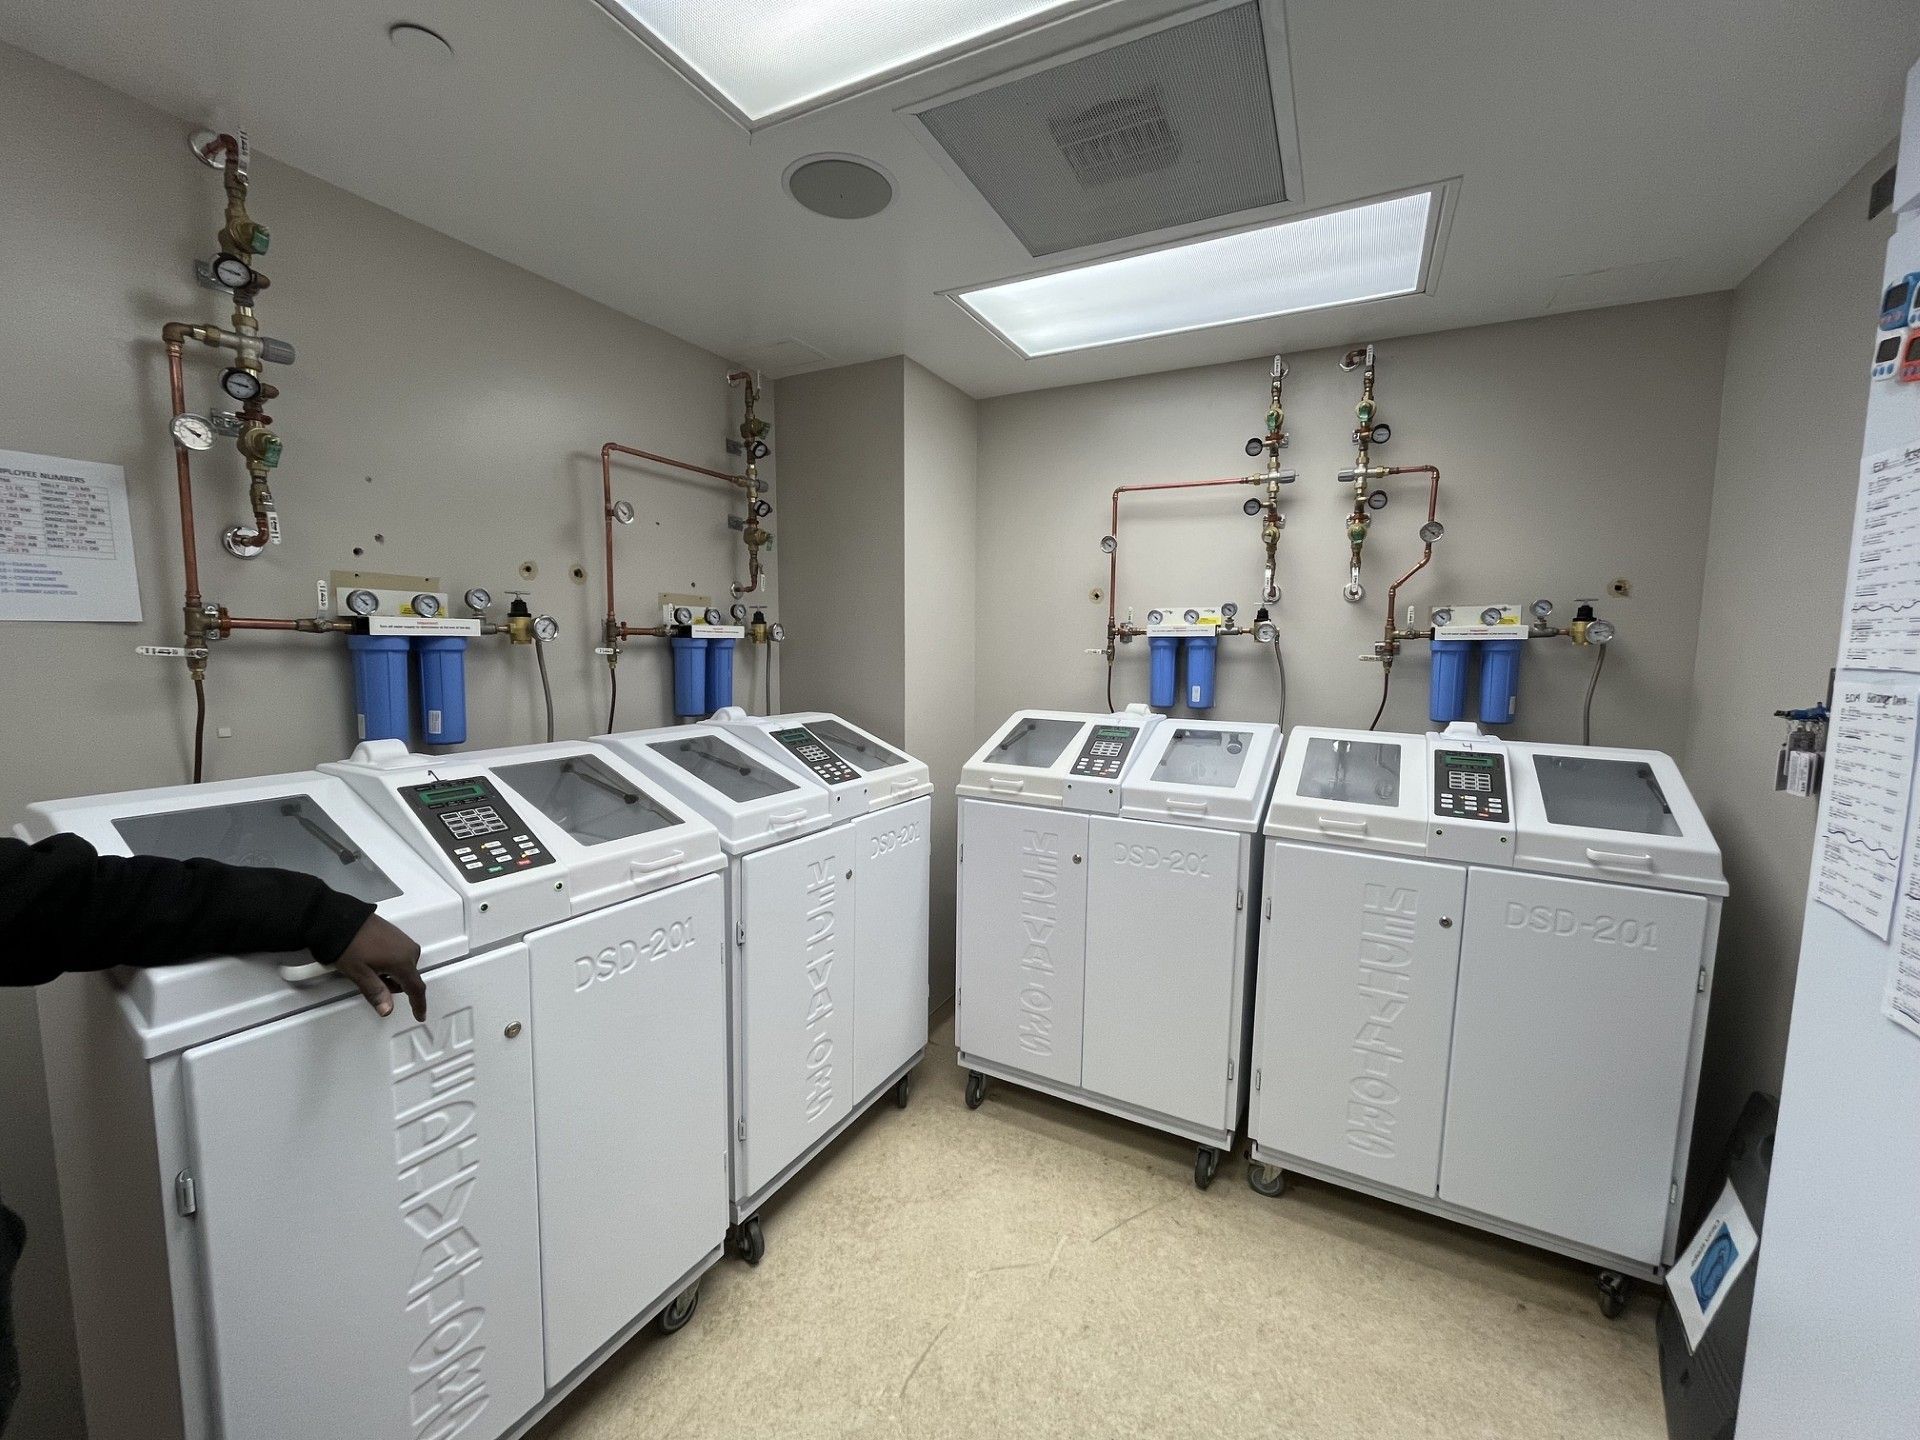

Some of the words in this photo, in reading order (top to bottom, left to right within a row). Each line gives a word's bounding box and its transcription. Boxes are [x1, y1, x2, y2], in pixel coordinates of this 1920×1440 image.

[40, 472, 86, 484] NUMBERS
[1462, 742, 1473, 751] 4
[870, 820, 921, 860] DSD-201
[1113, 841, 1210, 878] DSD-201
[574, 915, 696, 993] DSD-201
[1019, 829, 1059, 1057] MEDIVATORS
[1504, 901, 1660, 951] DSD-201
[806, 855, 836, 1124] MEDIVATORS
[1346, 883, 1419, 1159] MEDIVATORS
[390, 1005, 490, 1440] MEDIVATORS
